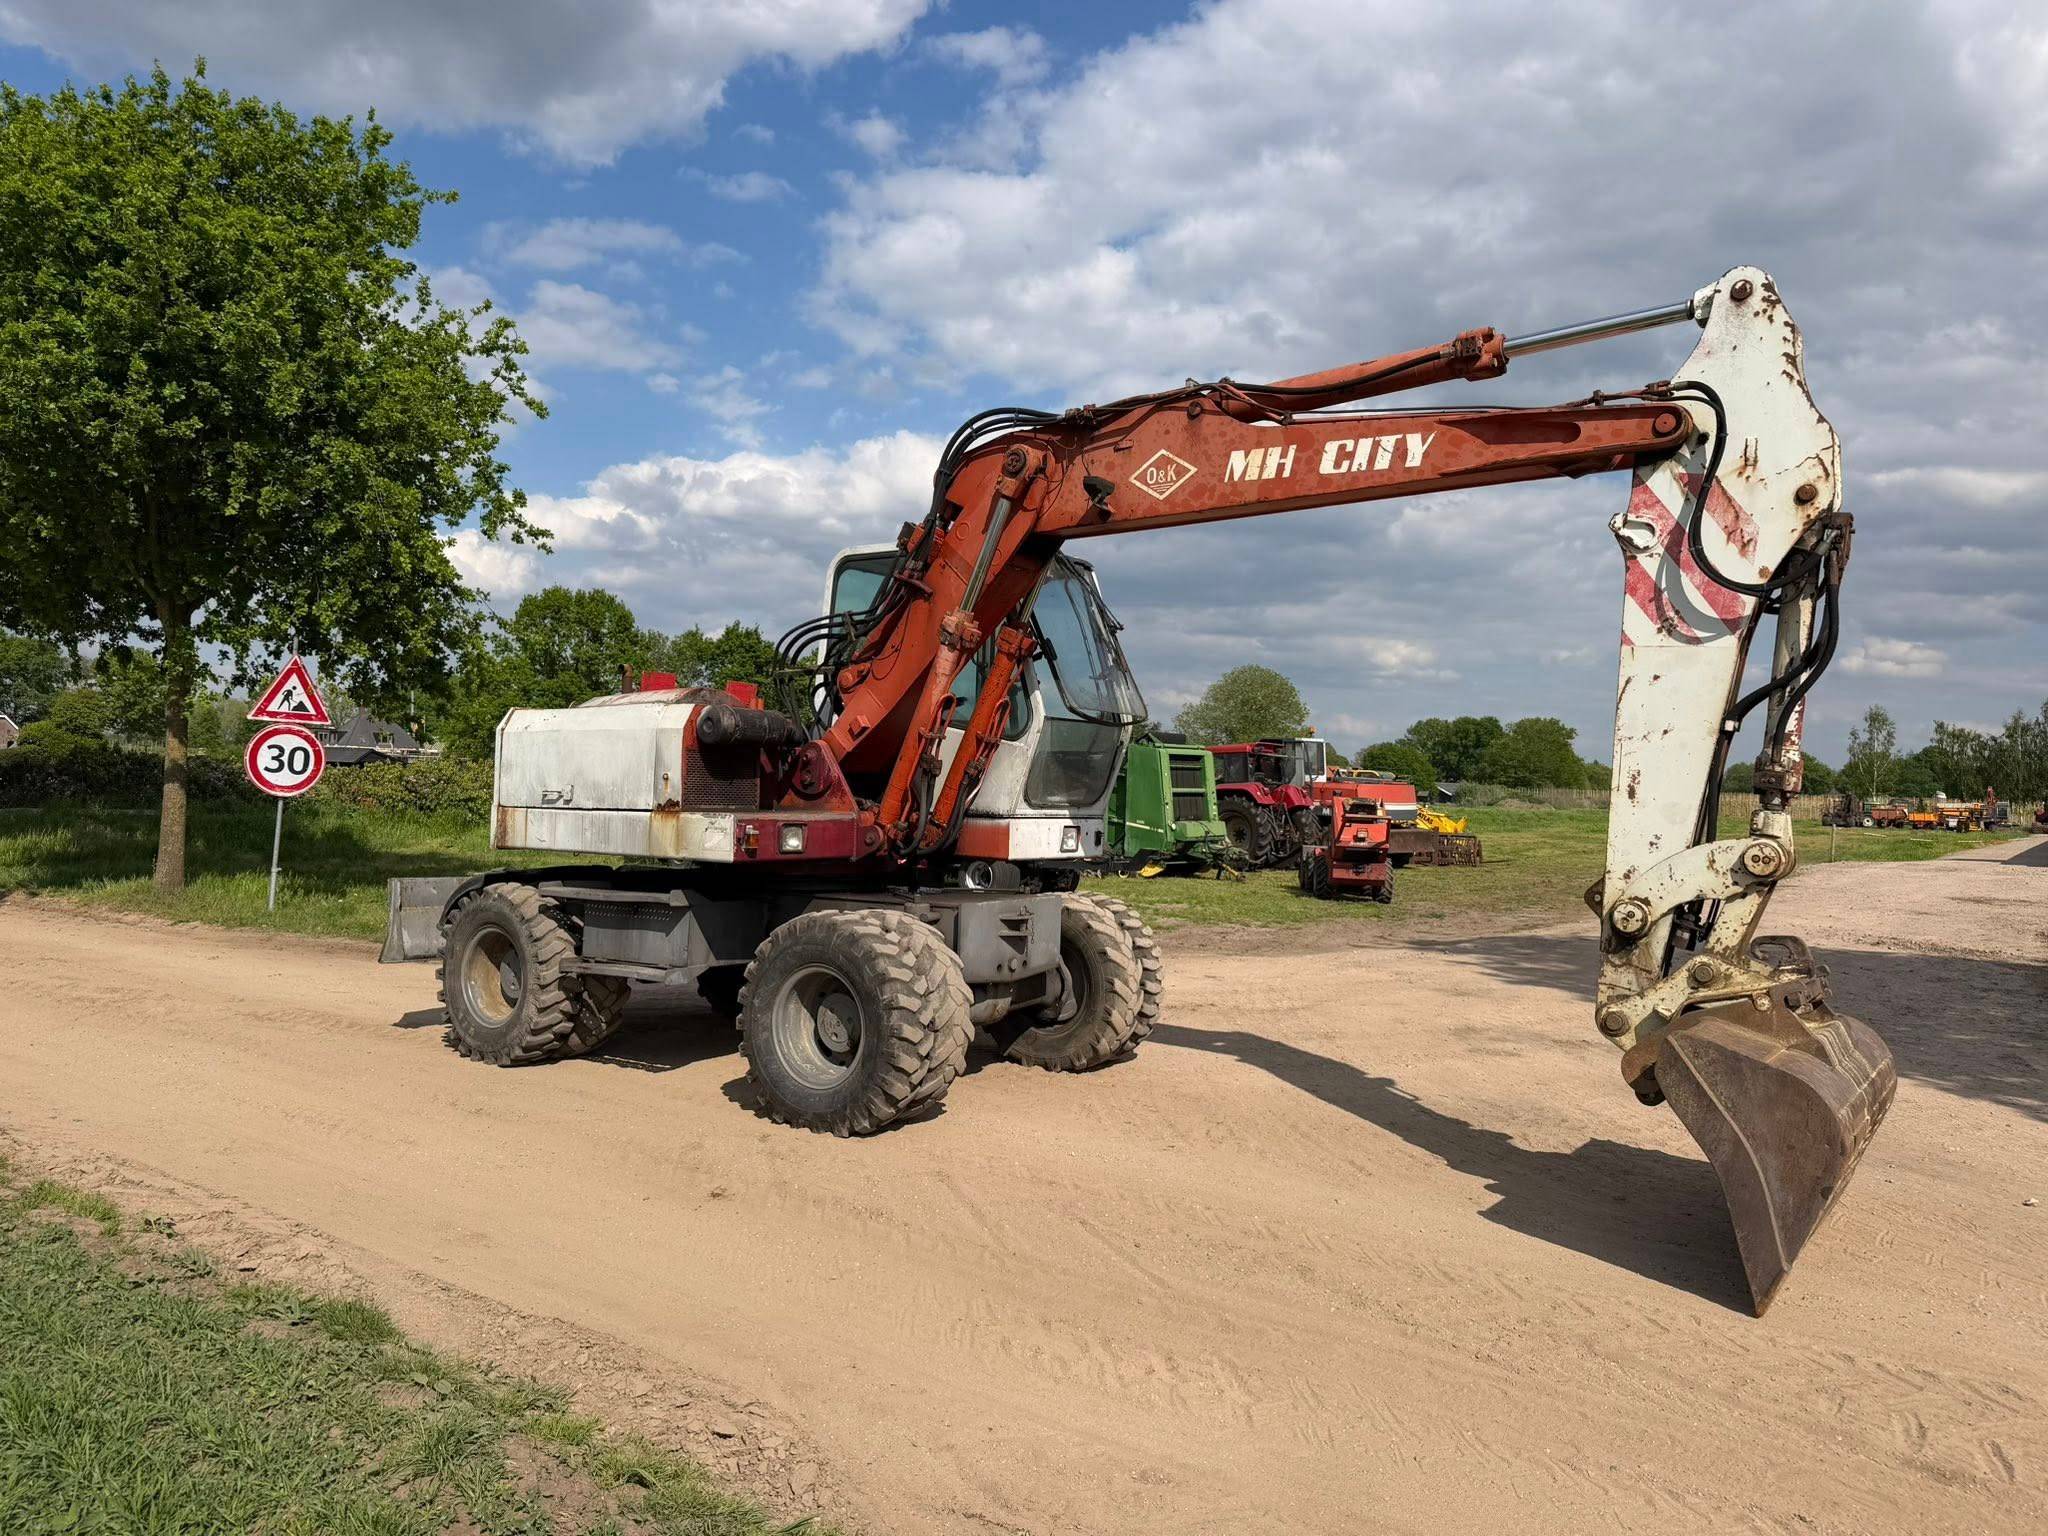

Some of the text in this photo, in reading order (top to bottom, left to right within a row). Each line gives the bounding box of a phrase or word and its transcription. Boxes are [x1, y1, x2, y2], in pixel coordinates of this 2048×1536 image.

[1224, 431, 1437, 483] MH CITY
[1146, 463, 1177, 484] O&K
[264, 744, 311, 775] 30
[1417, 811, 1434, 825] ATLAS
